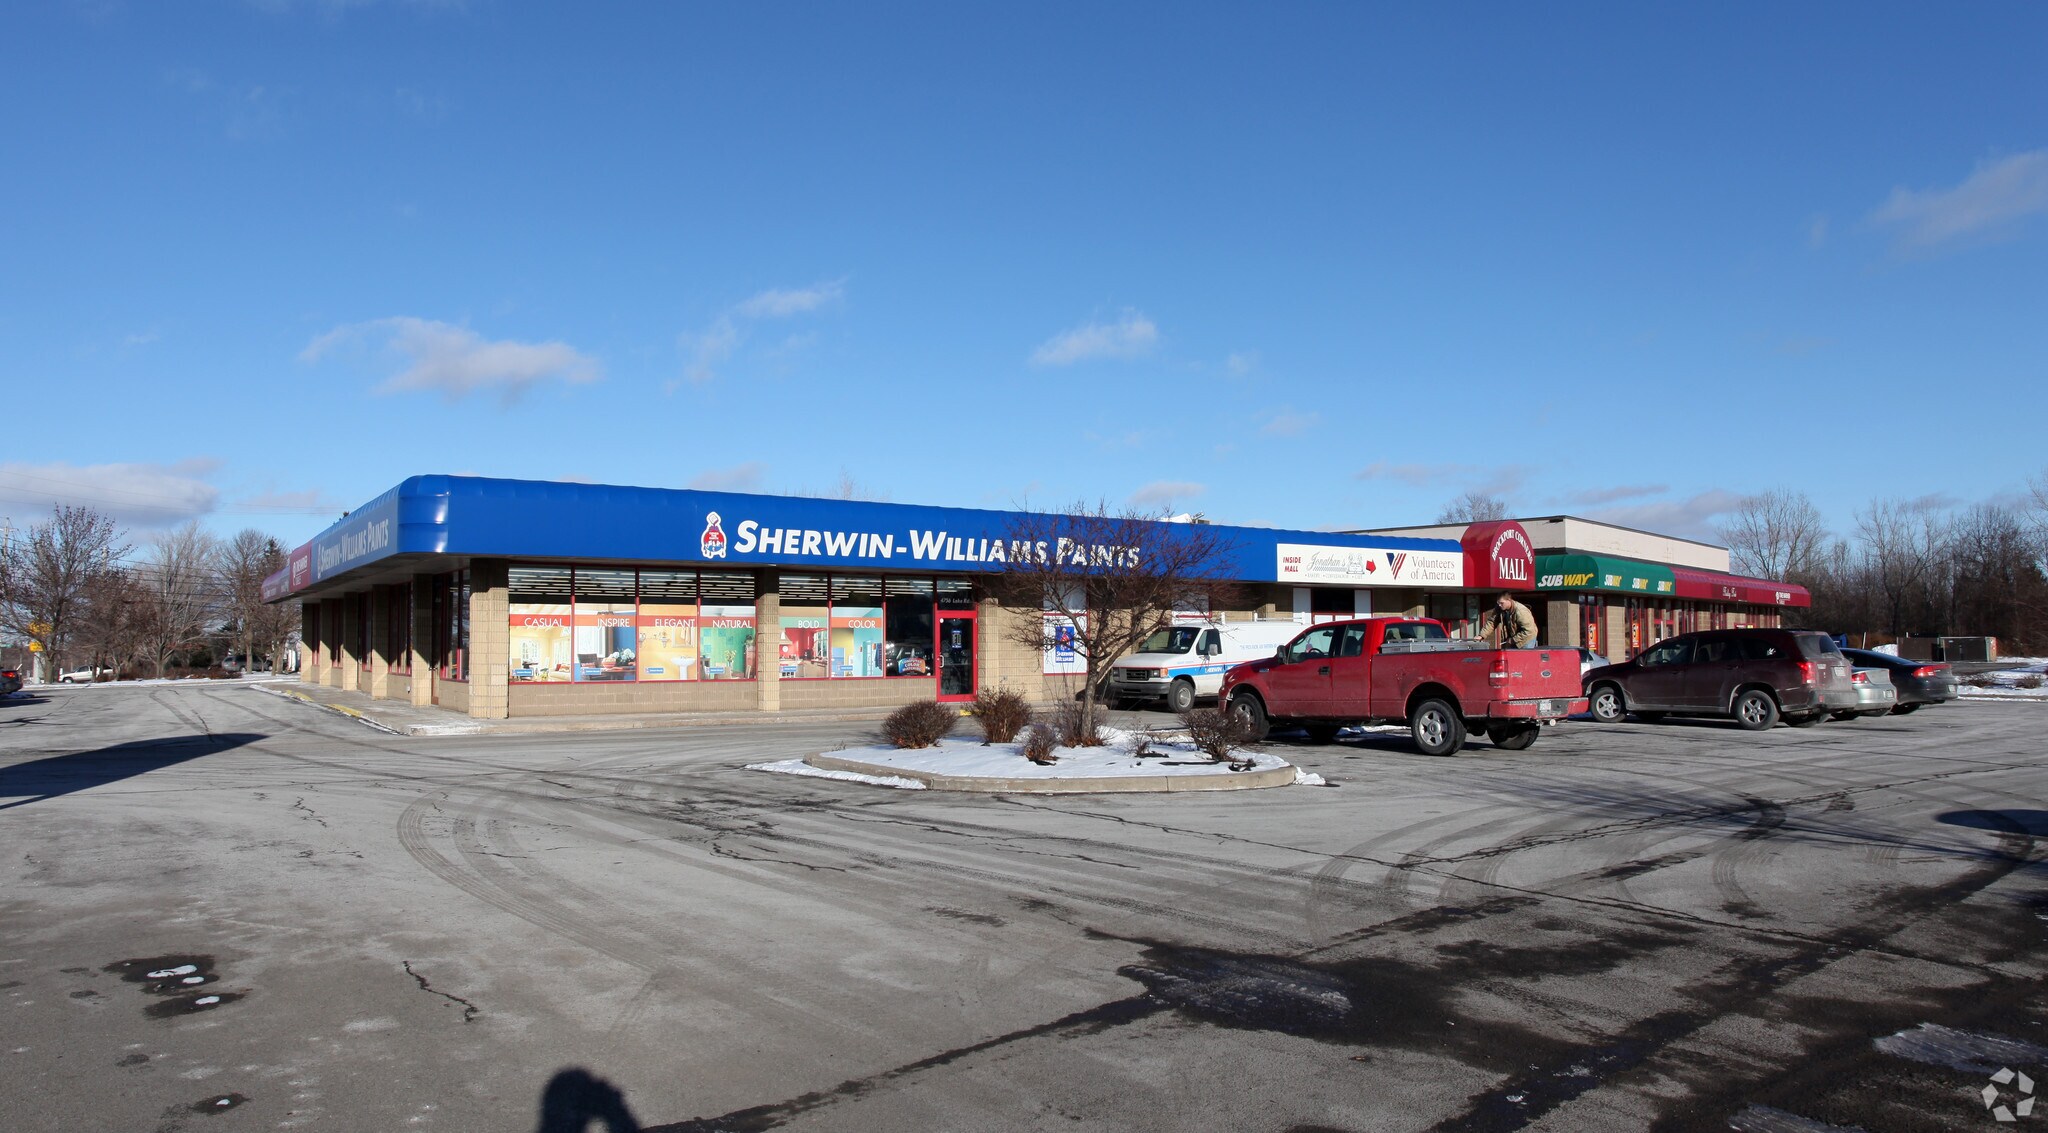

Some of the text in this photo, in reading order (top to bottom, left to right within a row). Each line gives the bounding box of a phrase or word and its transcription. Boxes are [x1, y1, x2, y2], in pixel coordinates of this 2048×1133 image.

[367, 519, 389, 553] PAINTS
[1056, 537, 1141, 569] PAINTS
[1491, 529, 1534, 565] BROCKPORT CORNERS
[1282, 556, 1302, 564] INSIDE
[1412, 556, 1455, 569] Volunteers
[1284, 565, 1299, 573] MALL
[1410, 569, 1456, 581] of America
[1499, 557, 1528, 581] MALL
[1538, 573, 1594, 587] SUBWAY
[1604, 574, 1622, 587] SUBWAY
[1632, 577, 1649, 590] SUBWAY
[1657, 580, 1673, 592] SUBWAY
[524, 617, 564, 627] CASUAL
[597, 618, 630, 628] INSPIRE
[655, 618, 695, 628] ELEGANT
[712, 619, 752, 629] NATURAL
[798, 620, 820, 629] BOLD
[848, 620, 876, 629] COLOR
